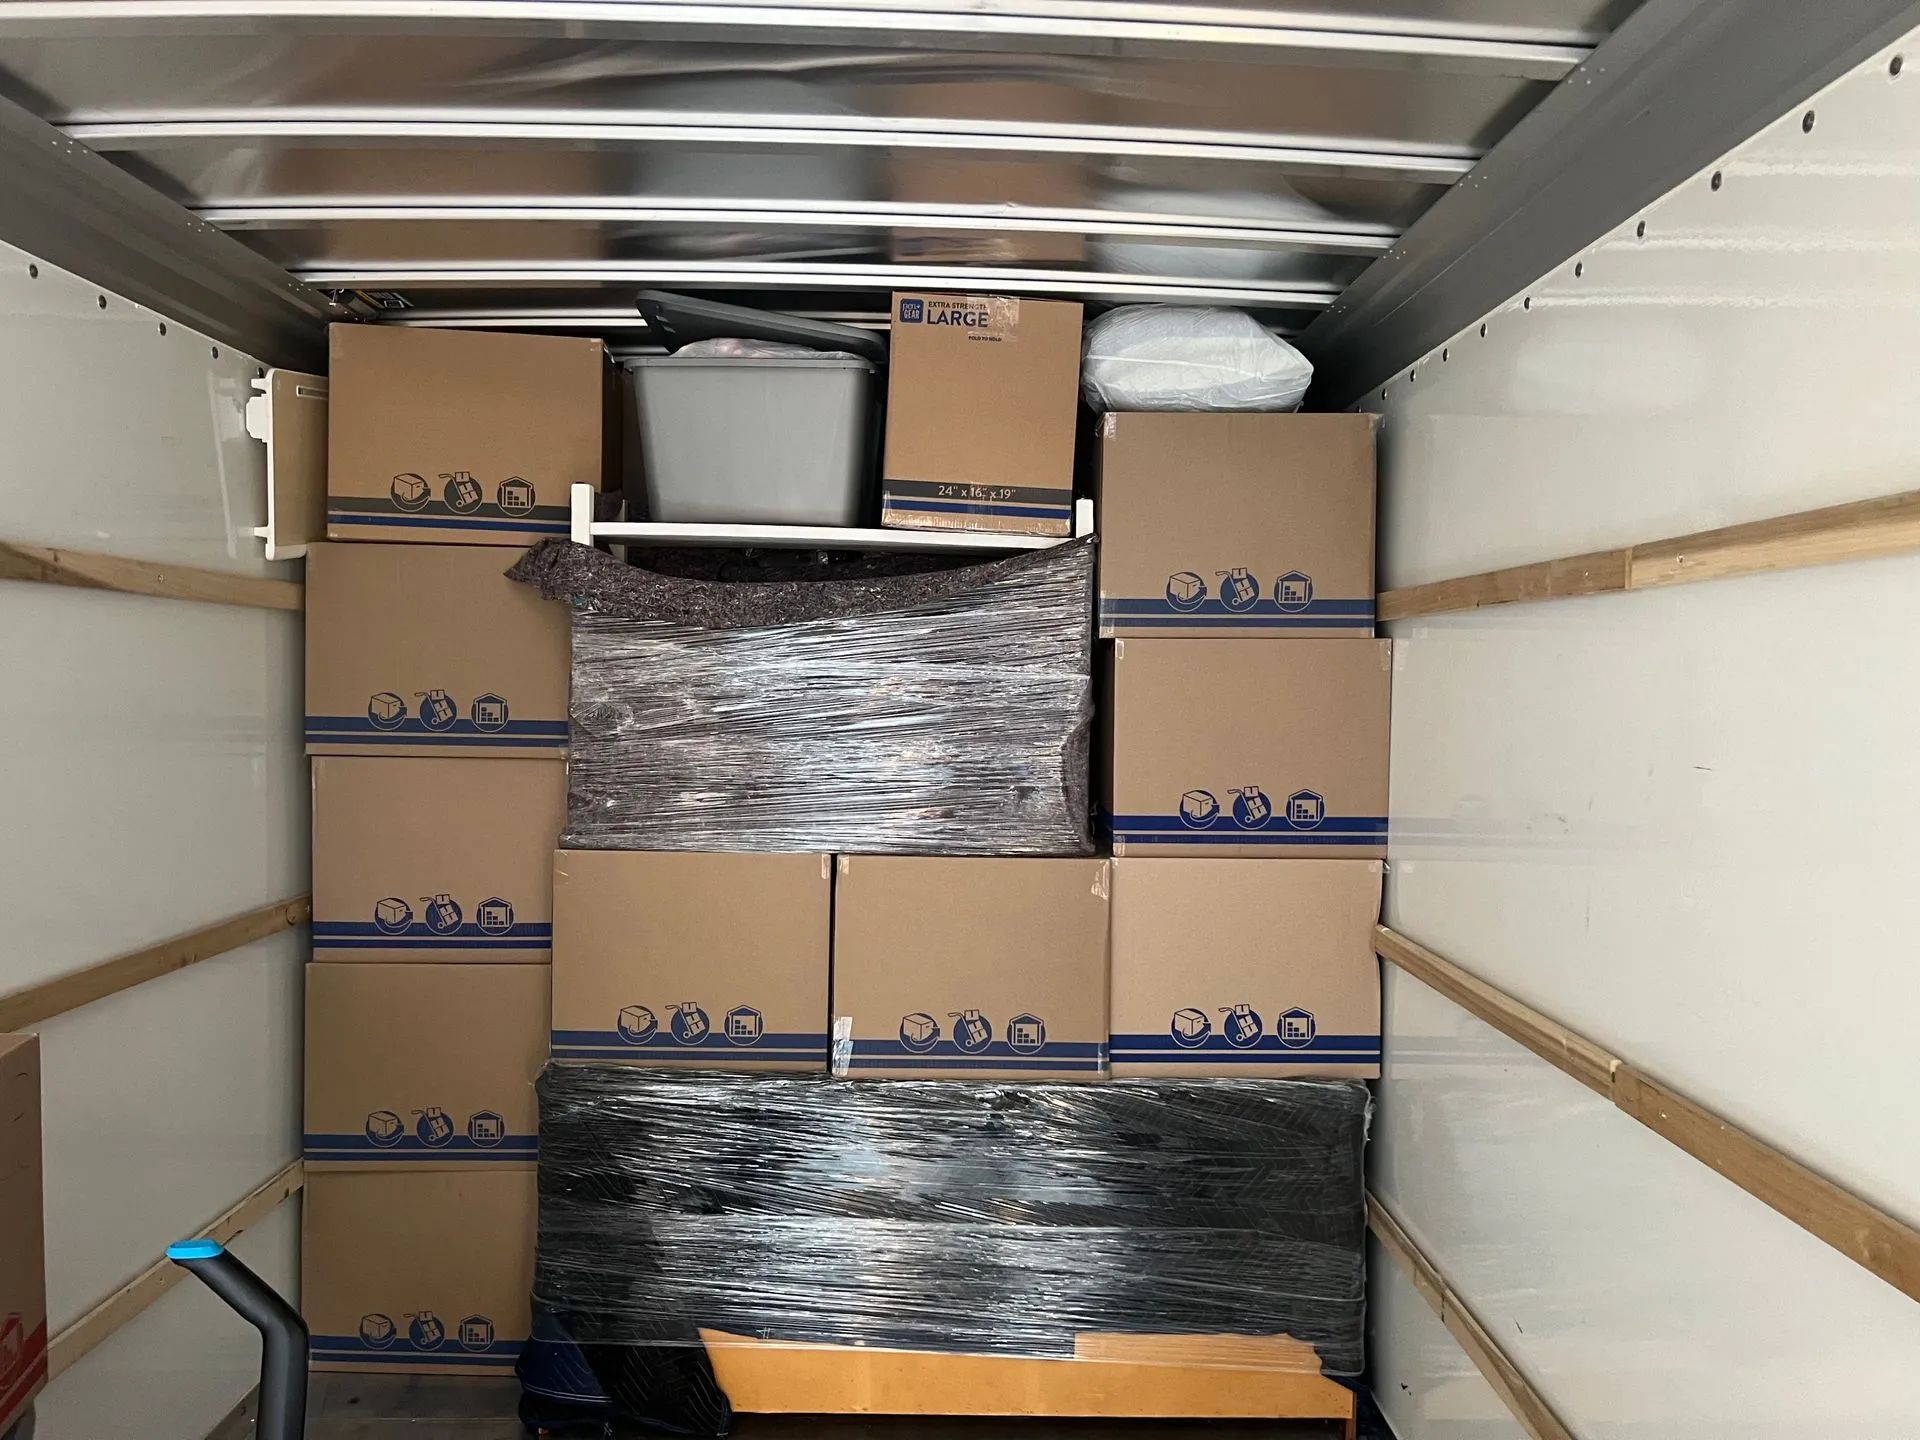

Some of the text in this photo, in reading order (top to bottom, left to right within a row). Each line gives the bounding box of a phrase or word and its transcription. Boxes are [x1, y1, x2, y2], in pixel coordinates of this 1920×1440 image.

[903, 310, 920, 319] GEAR
[927, 309, 989, 328] LARGE
[938, 485, 958, 497] 24"
[961, 489, 968, 497] x
[990, 491, 997, 499] x
[999, 488, 1016, 499] 19"
